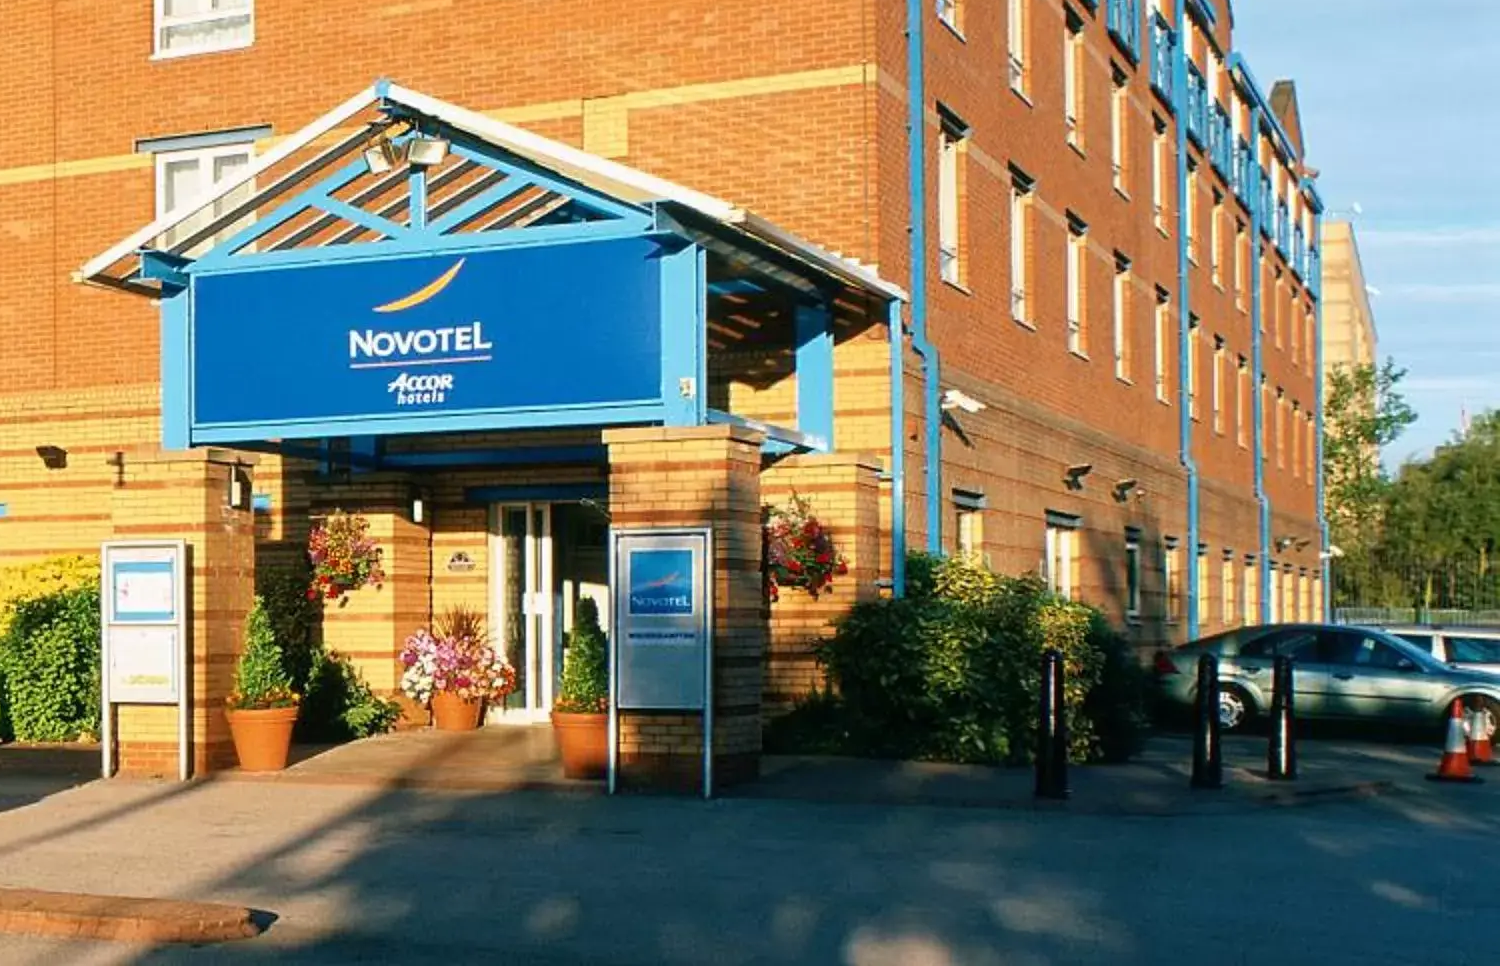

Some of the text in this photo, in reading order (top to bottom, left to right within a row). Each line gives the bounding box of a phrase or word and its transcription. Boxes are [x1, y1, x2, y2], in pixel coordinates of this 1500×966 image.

[349, 321, 493, 358] NOVOTEL
[397, 389, 445, 405] hotels
[631, 595, 691, 607] NOVOTEL
